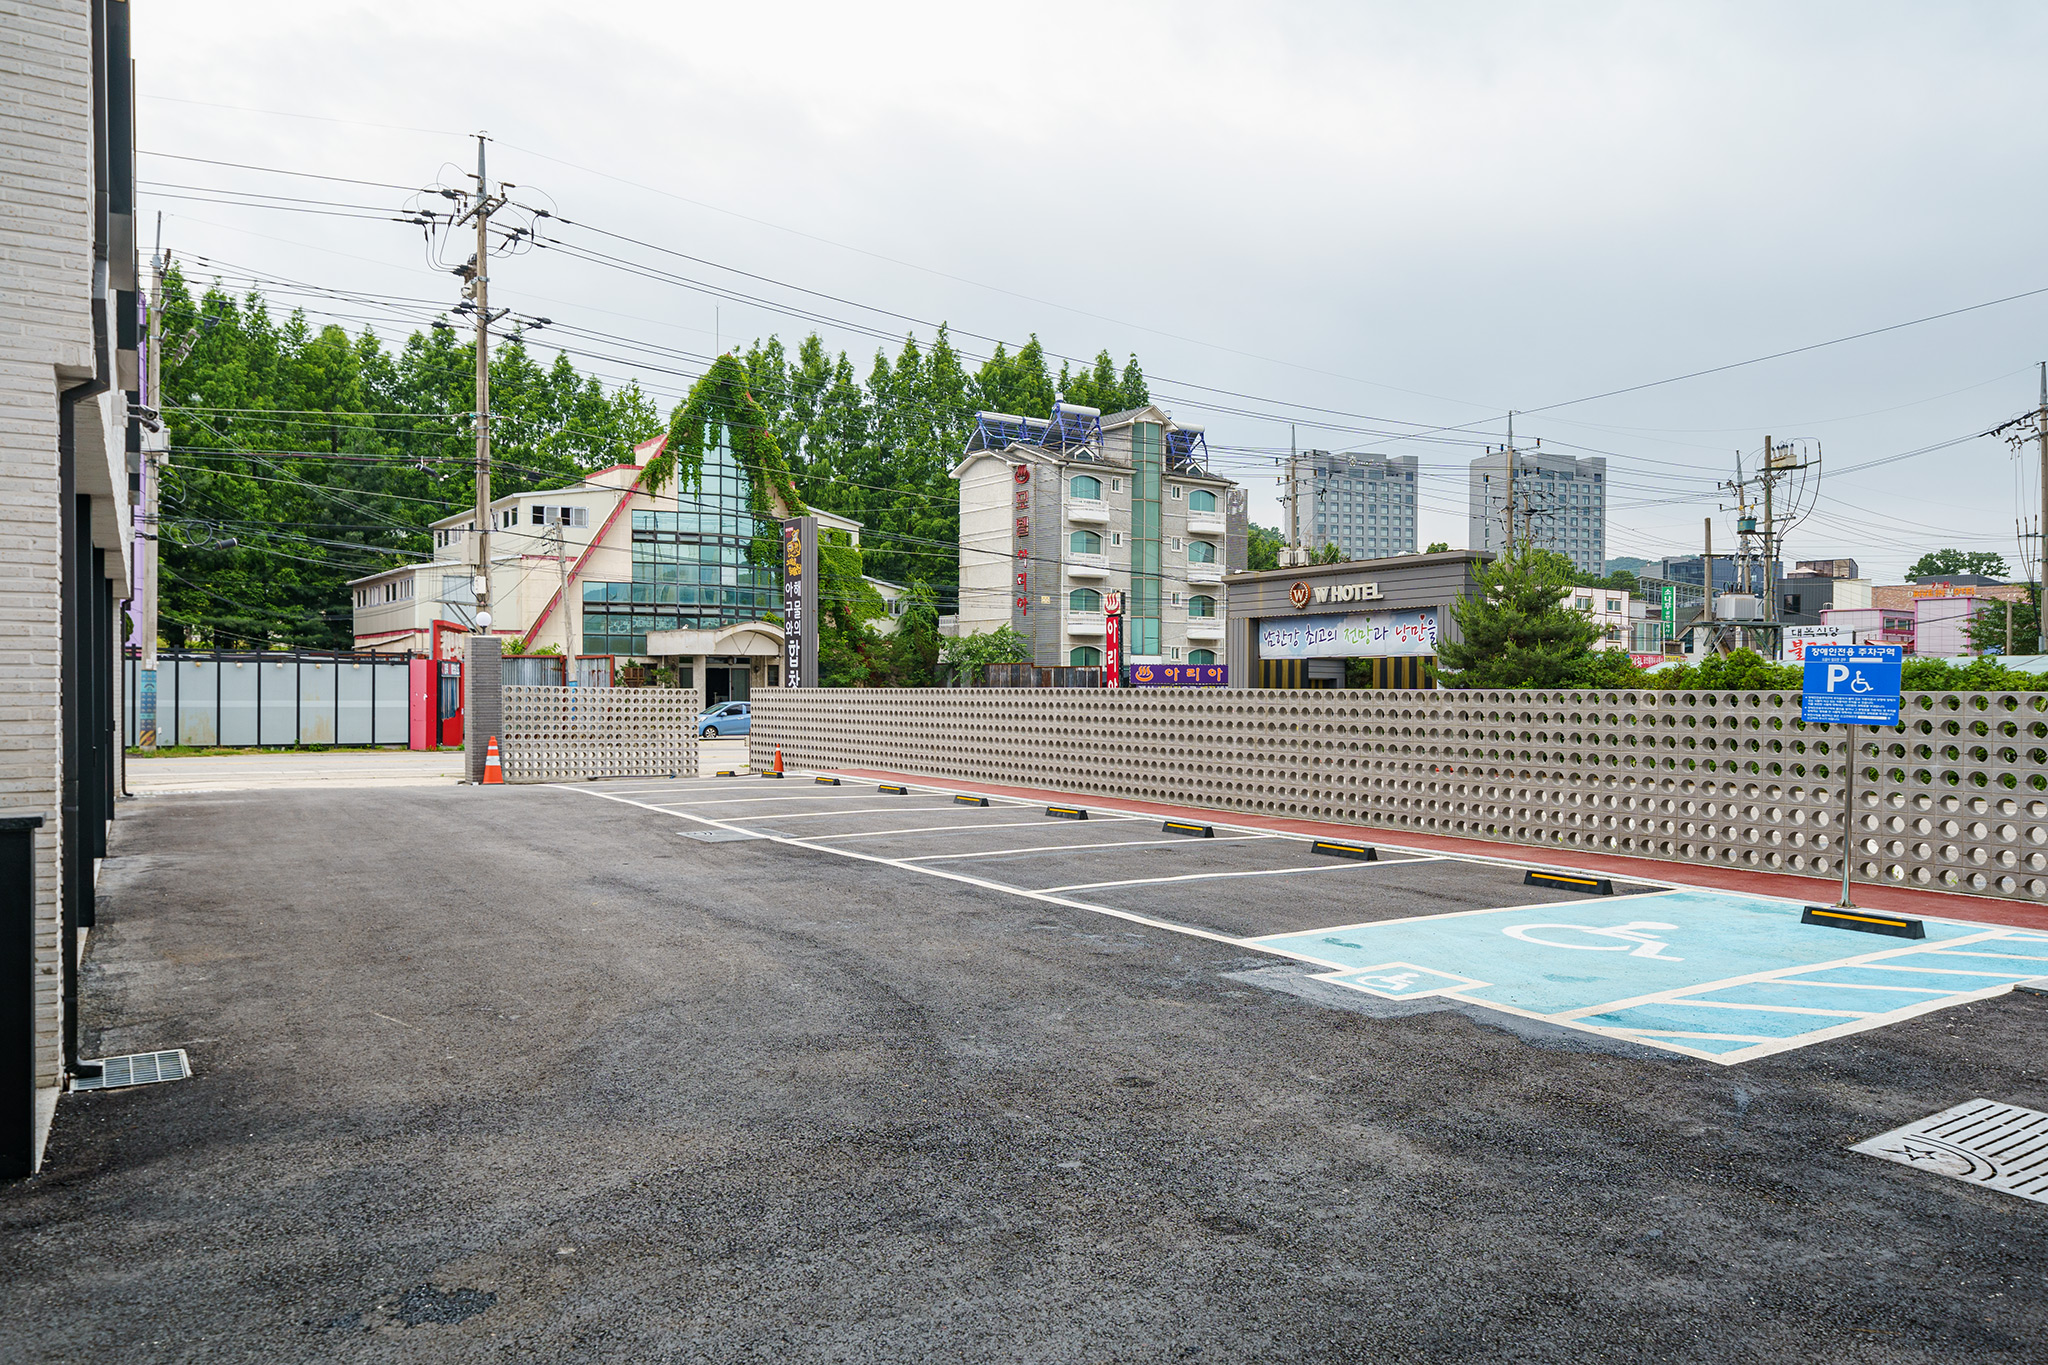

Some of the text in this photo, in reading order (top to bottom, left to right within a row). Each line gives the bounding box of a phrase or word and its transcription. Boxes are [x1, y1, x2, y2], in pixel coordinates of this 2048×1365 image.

[1016, 490, 1029, 616] 모텔 아리아
[1313, 582, 1384, 603] W HOTEL
[1908, 589, 1933, 598] DRIVE
[1935, 589, 1946, 597] IN
[793, 580, 802, 636] 해물의
[1263, 617, 1437, 649] 남한강 최고의 전망과 낭만을
[1811, 647, 1855, 657] 장애인전용
[1858, 647, 1896, 657] 주차구역
[1165, 667, 1223, 682] 아리아
[1826, 664, 1850, 692] P
